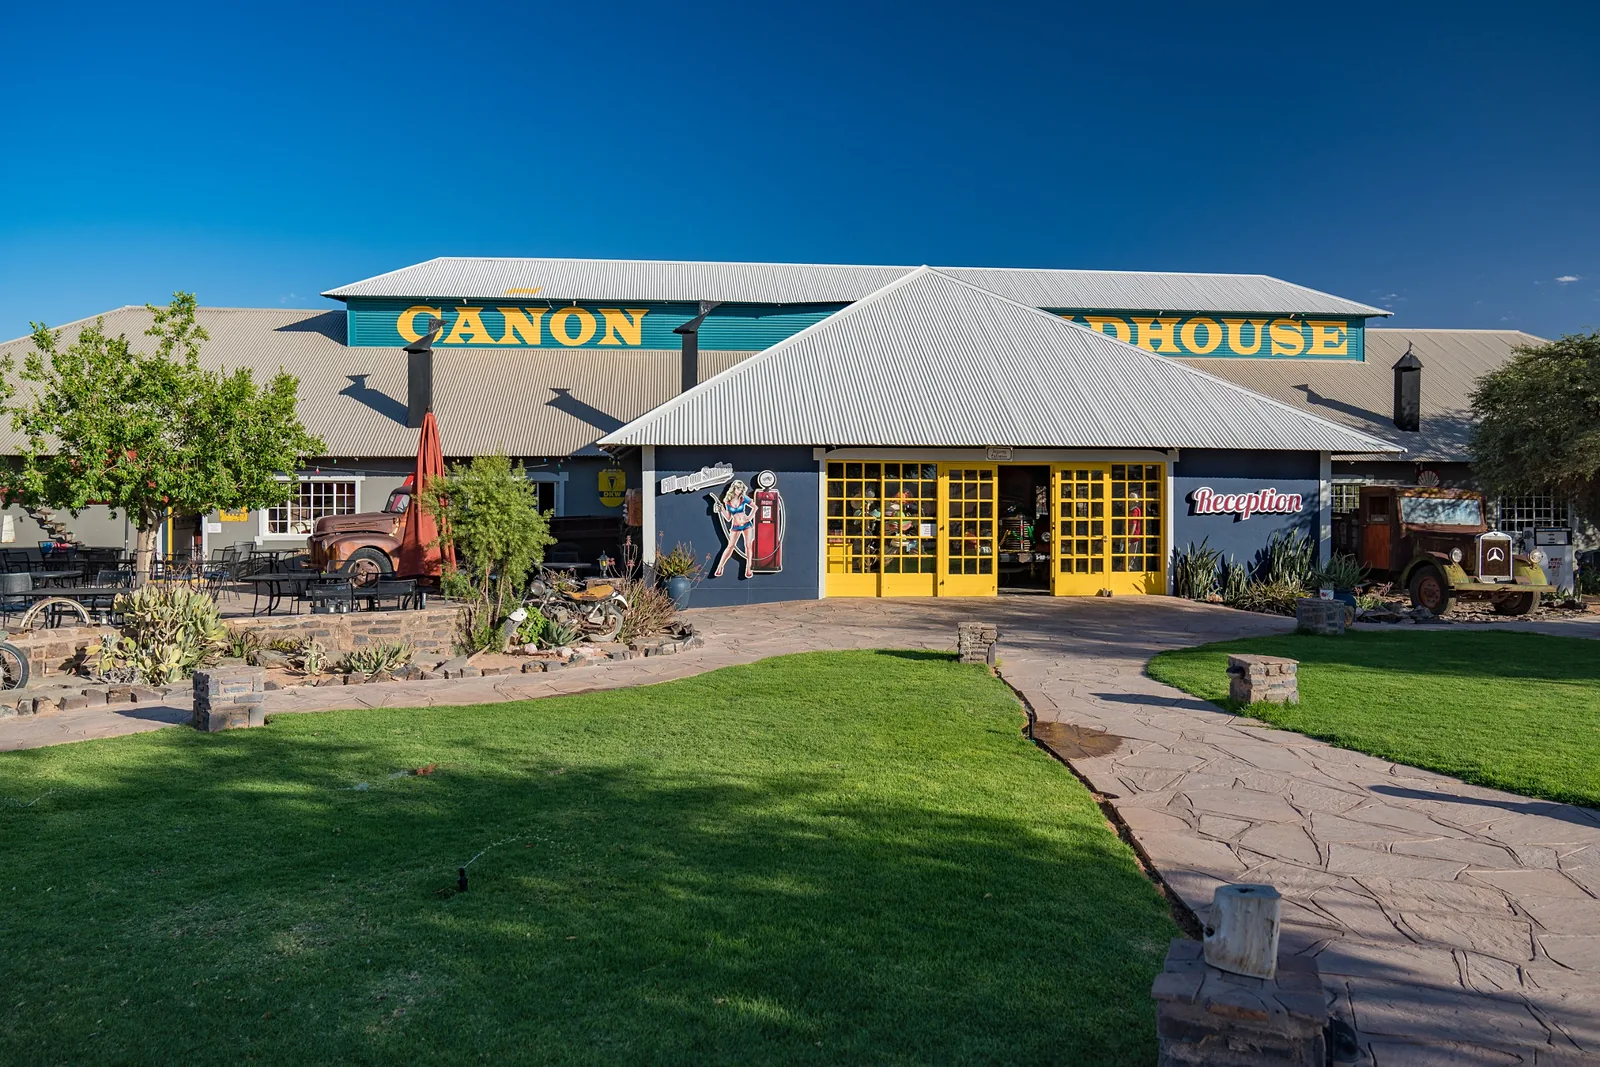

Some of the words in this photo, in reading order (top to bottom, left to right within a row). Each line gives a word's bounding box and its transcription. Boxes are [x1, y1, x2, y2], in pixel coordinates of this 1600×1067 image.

[397, 305, 650, 347] CANON
[1061, 316, 1348, 356] DHOUSE
[662, 476, 677, 493] Fill
[677, 477, 690, 491] up
[689, 472, 702, 485] on
[1194, 487, 1303, 520] Reception
